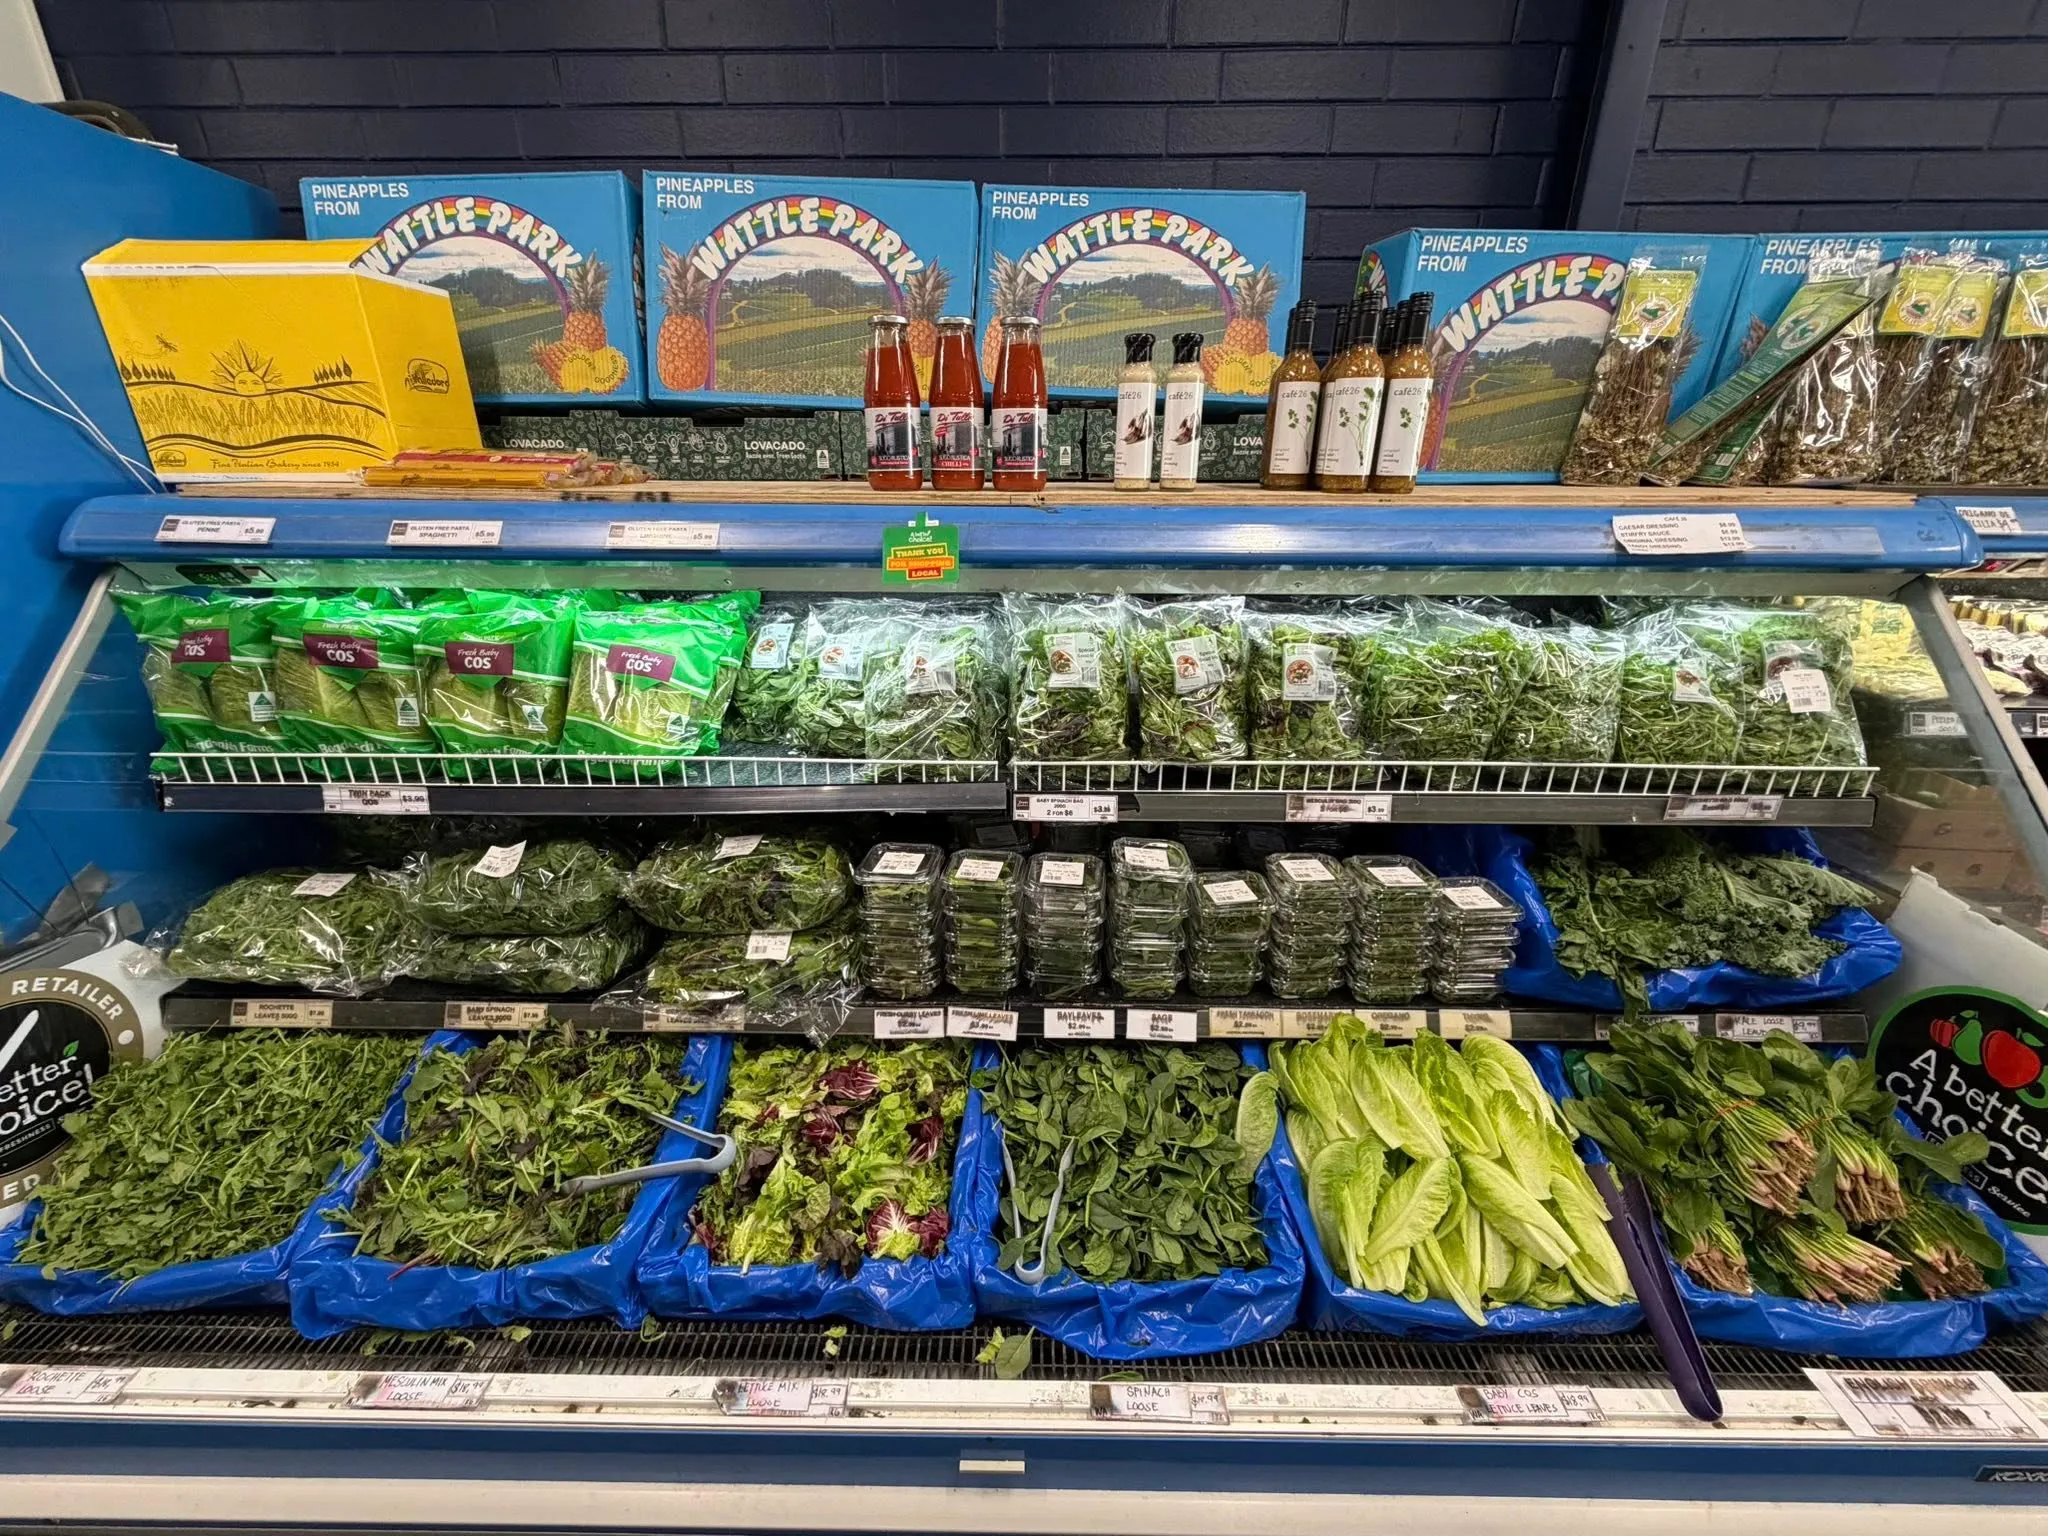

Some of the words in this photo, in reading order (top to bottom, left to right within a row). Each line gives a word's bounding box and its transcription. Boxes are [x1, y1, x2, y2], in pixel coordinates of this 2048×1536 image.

[312, 183, 409, 199] PINEAPPLES
[656, 177, 755, 194] PINEAPPLES
[656, 194, 702, 209] FROM
[992, 192, 1090, 207] PINEAPPLES
[314, 201, 360, 216] FROM
[992, 206, 1037, 220] FROM
[354, 196, 477, 275] WATTLE
[486, 202, 583, 278] PARK
[692, 197, 820, 281] WATTLE
[830, 203, 924, 284] PARK
[1023, 208, 1153, 284] WATTLE
[1160, 214, 1256, 287] PARK
[1420, 236, 1528, 254] PINEAPPLES
[1417, 255, 1468, 272] FROM
[1760, 258, 1812, 275] FROM
[1441, 255, 1593, 353] WATTLE
[568, 352, 596, 370] GOLDEN
[1168, 391, 1193, 400] café26
[1282, 389, 1308, 399] café26
[1335, 386, 1360, 396] café26
[1393, 387, 1422, 396] café26
[503, 439, 565, 449] LOVACADO
[744, 441, 806, 450] LOVACADO
[210, 459, 231, 469] Fine
[266, 459, 300, 469] Bakery
[926, 547, 944, 555] YOU
[911, 569, 939, 577] LOCAL
[184, 645, 206, 656] COS
[317, 641, 339, 650] Fresh
[340, 641, 362, 652] Baby
[327, 650, 355, 663] COS
[457, 648, 479, 656] Fresh
[480, 648, 501, 659] Baby
[620, 651, 642, 660] Fresh
[642, 655, 662, 667] Baby
[464, 656, 492, 669] COS
[625, 658, 653, 672] COS
[348, 790, 368, 798] TWIN
[11, 976, 124, 1021] RETAILER
[1151, 1013, 1173, 1022] SAGE
[1763, 1017, 1785, 1025] LOOSE
[1910, 1049, 1937, 1081] A
[1987, 1186, 2031, 1218] Service
[429, 1376, 449, 1387] MIX
[777, 1382, 800, 1393] MIX
[1843, 1377, 1908, 1391] ENGLISH
[1910, 1377, 1979, 1391] SPINACH
[16, 1385, 56, 1394] LOOSE
[1126, 1386, 1171, 1397] SPINACH
[1484, 1388, 1509, 1400] BABY
[1517, 1388, 1539, 1398] COS
[386, 1391, 423, 1401] LOOSE
[746, 1398, 781, 1407] LOOSE
[1126, 1402, 1159, 1412] LOOSE
[1487, 1403, 1525, 1414] LETTUCE
[1527, 1402, 1558, 1413] LEAVES
[1470, 1409, 1483, 1420] WA
